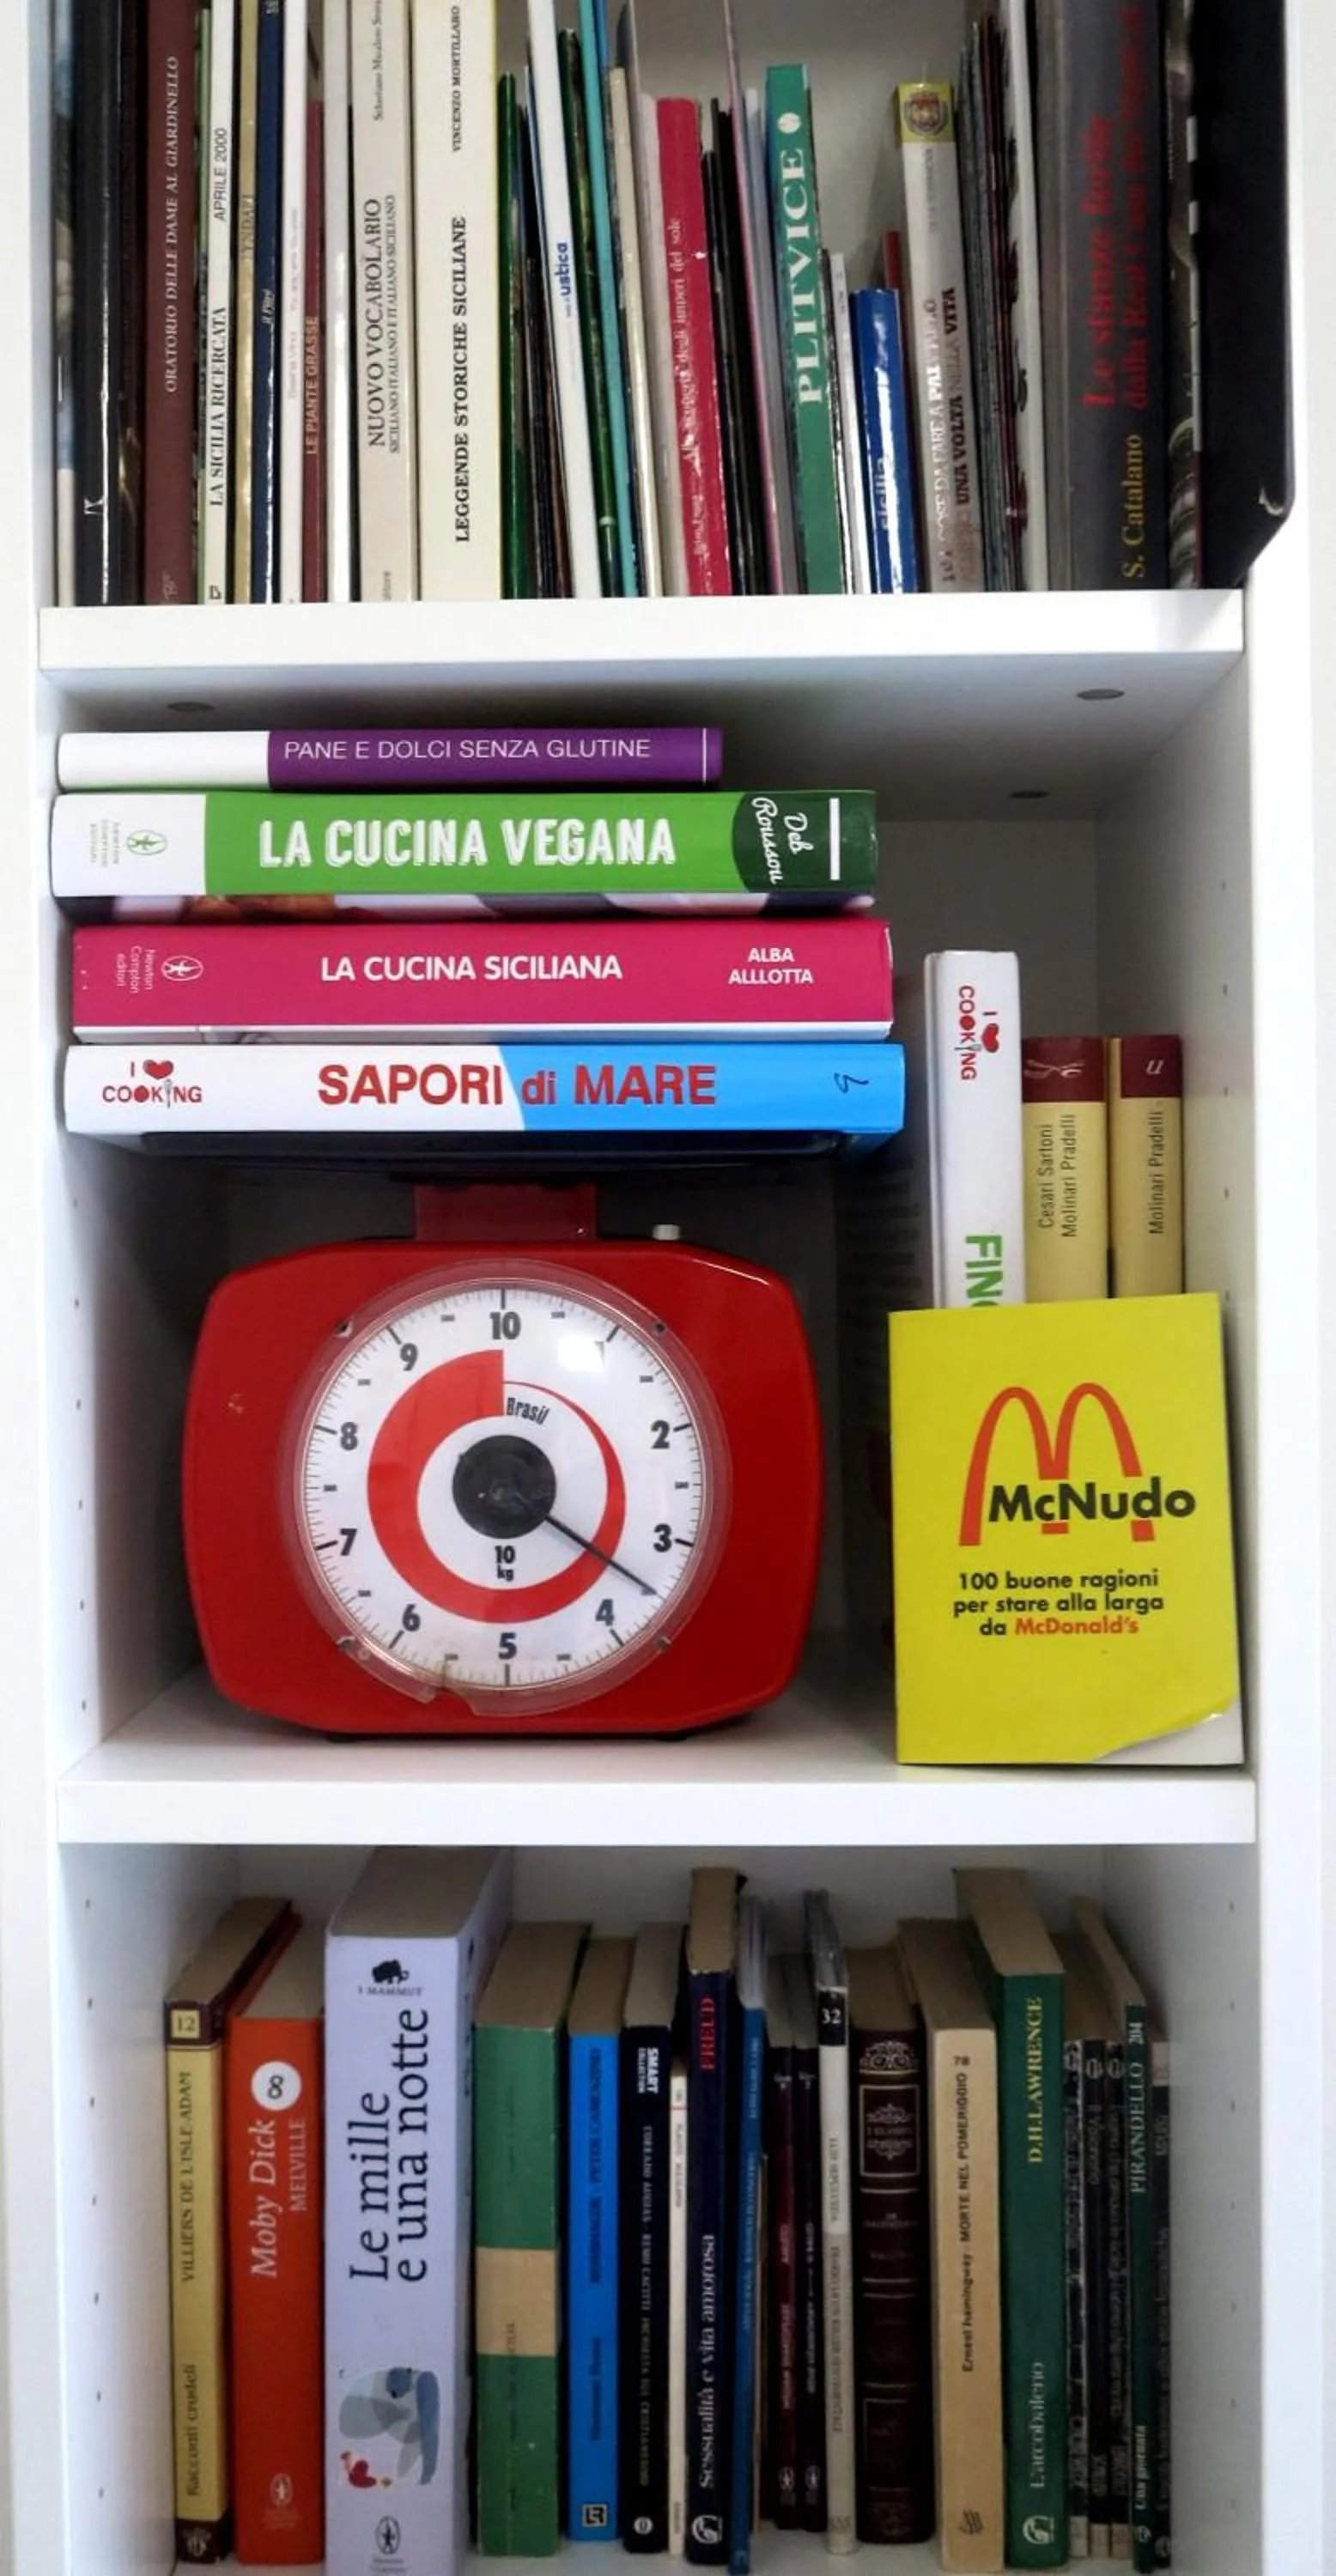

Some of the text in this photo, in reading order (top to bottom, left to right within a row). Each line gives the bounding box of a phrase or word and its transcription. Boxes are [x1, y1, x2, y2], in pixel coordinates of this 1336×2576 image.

[451, 4, 462, 153] VINCENZO MORTILLARO
[213, 127, 227, 222] APRILE 2000
[164, 56, 179, 393] ORATORIO DELLE DAME AL GIARDINELLO
[554, 242, 572, 296] ustica
[780, 149, 823, 404] PLITVICE
[363, 197, 386, 447] NUOVO VOCABOLARIO
[941, 287, 959, 336] VITA
[306, 317, 319, 454] LE PIANTE GRASSE
[452, 216, 471, 543] LEGGENDE STORICHE SICILIANE
[210, 307, 227, 507] LA SICILIA RICERCATA
[949, 395, 969, 462] VOLTA
[953, 464, 971, 507] UNA
[1120, 434, 1145, 579] S. Catalano
[283, 738, 651, 760] PANE E DOLCI SENZA GLUTINE
[259, 818, 676, 868] LA CUCINA VEGANA
[783, 811, 815, 854] Deb
[321, 954, 622, 982] LA CUCINA SICILIANA
[728, 968, 813, 986] ALLLOTTA
[748, 947, 794, 963] ALBA
[318, 1062, 716, 1107] SAPORI di MARE
[1036, 1123, 1054, 1230] Cesari Sartoni
[1059, 1114, 1078, 1237] Molinari Pradelli
[1147, 1110, 1165, 1234] Molinari Pradelli
[964, 1233, 1004, 1307] FIN
[489, 1311, 522, 1340] 10
[399, 1342, 419, 1371] 9
[505, 1397, 550, 1425] Brasil
[650, 1420, 671, 1449] 2
[339, 1421, 359, 1451] 8
[988, 1476, 1197, 1522] McNudo
[338, 1528, 358, 1556] 7
[495, 1546, 515, 1564] 10
[653, 1523, 672, 1552] 3
[496, 1565, 514, 1582] kg
[959, 1568, 1159, 1593] 100 buone ragioni
[402, 1603, 422, 1631] 6
[594, 1599, 615, 1626] 4
[953, 1592, 1164, 1618] per stare alla larga
[979, 1614, 1139, 1636] da McDonald's
[498, 1632, 516, 1660] 5
[175, 2014, 197, 2032] 12
[699, 1996, 716, 2070] FREUD
[822, 2008, 841, 2025] 32
[647, 2046, 659, 2094] SMART
[955, 2072, 969, 2160] POMERIGGIO
[1128, 2062, 1147, 2193] PIRANDELLO
[288, 2117, 307, 2212] MELVILLE
[391, 2008, 429, 2283] e una notte
[182, 2182, 194, 2202] DE
[246, 2118, 284, 2278] Moby Dick
[346, 2093, 391, 2281] Le mille
[956, 2163, 969, 2190] NEL
[957, 2191, 970, 2243] MORTE
[181, 2208, 195, 2282] VILLIERS
[697, 2234, 716, 2488] Sessualità e vita amorosa
